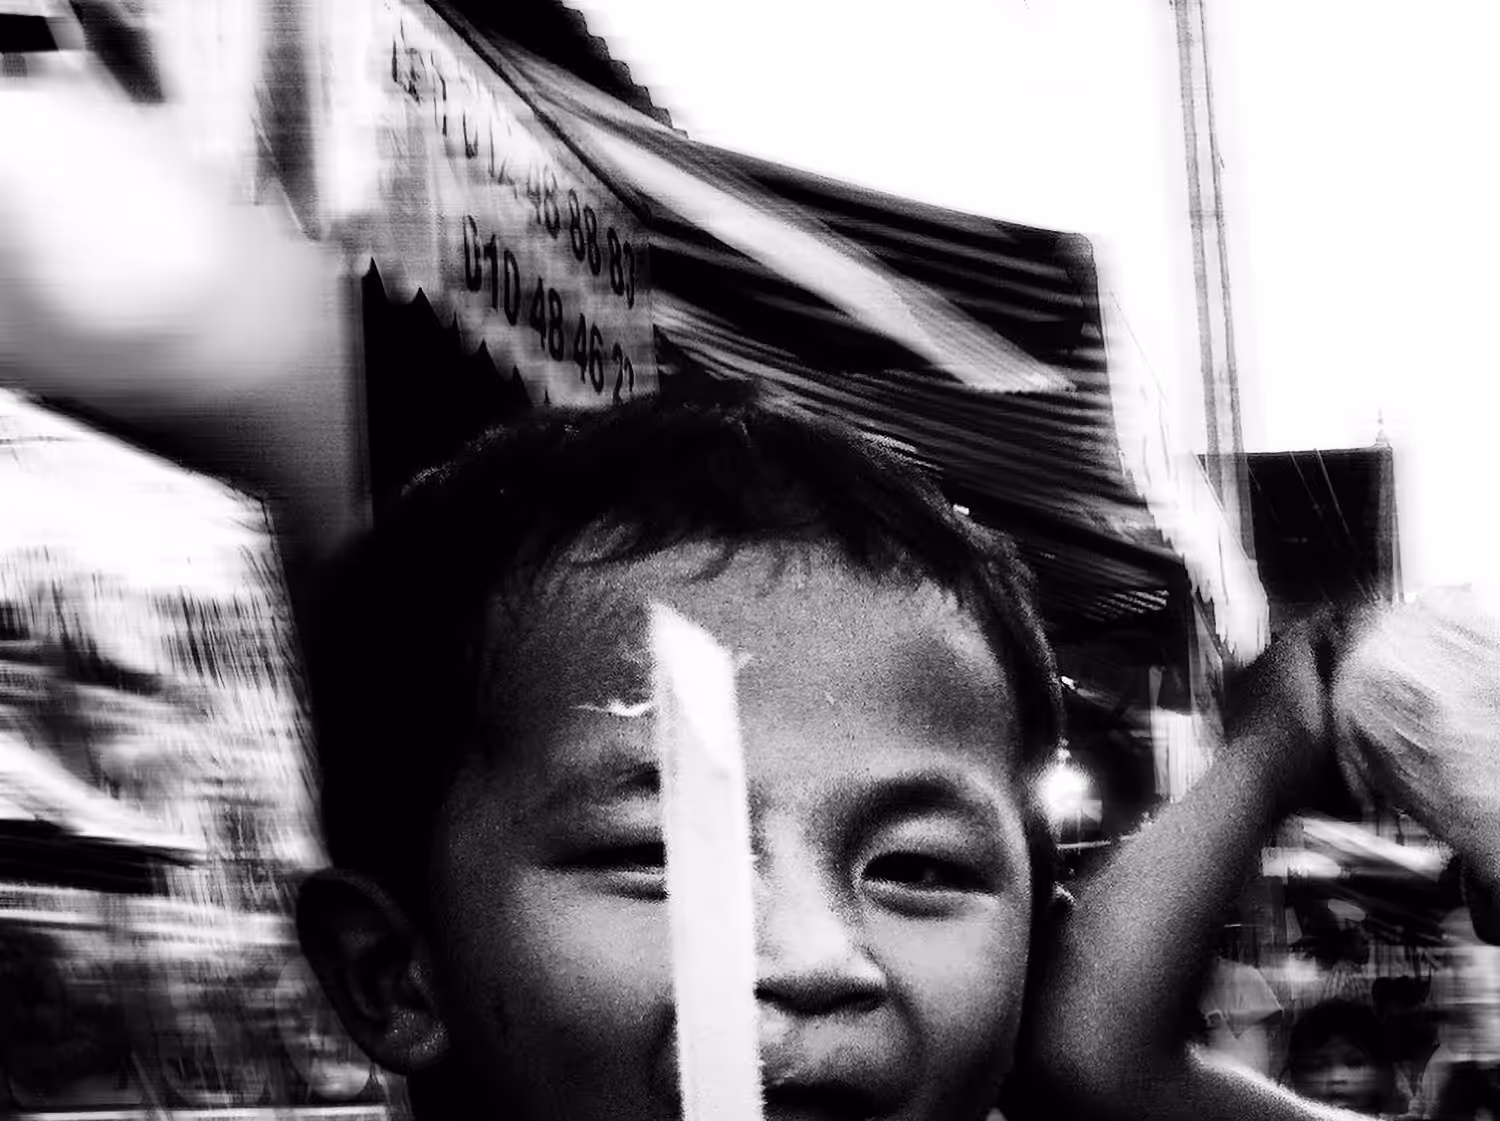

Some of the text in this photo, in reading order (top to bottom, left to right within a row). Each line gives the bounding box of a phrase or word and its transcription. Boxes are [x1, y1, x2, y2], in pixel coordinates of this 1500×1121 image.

[568, 188, 601, 277] 88
[462, 214, 521, 326] 010
[530, 276, 564, 362] 48
[574, 313, 605, 395] 46
